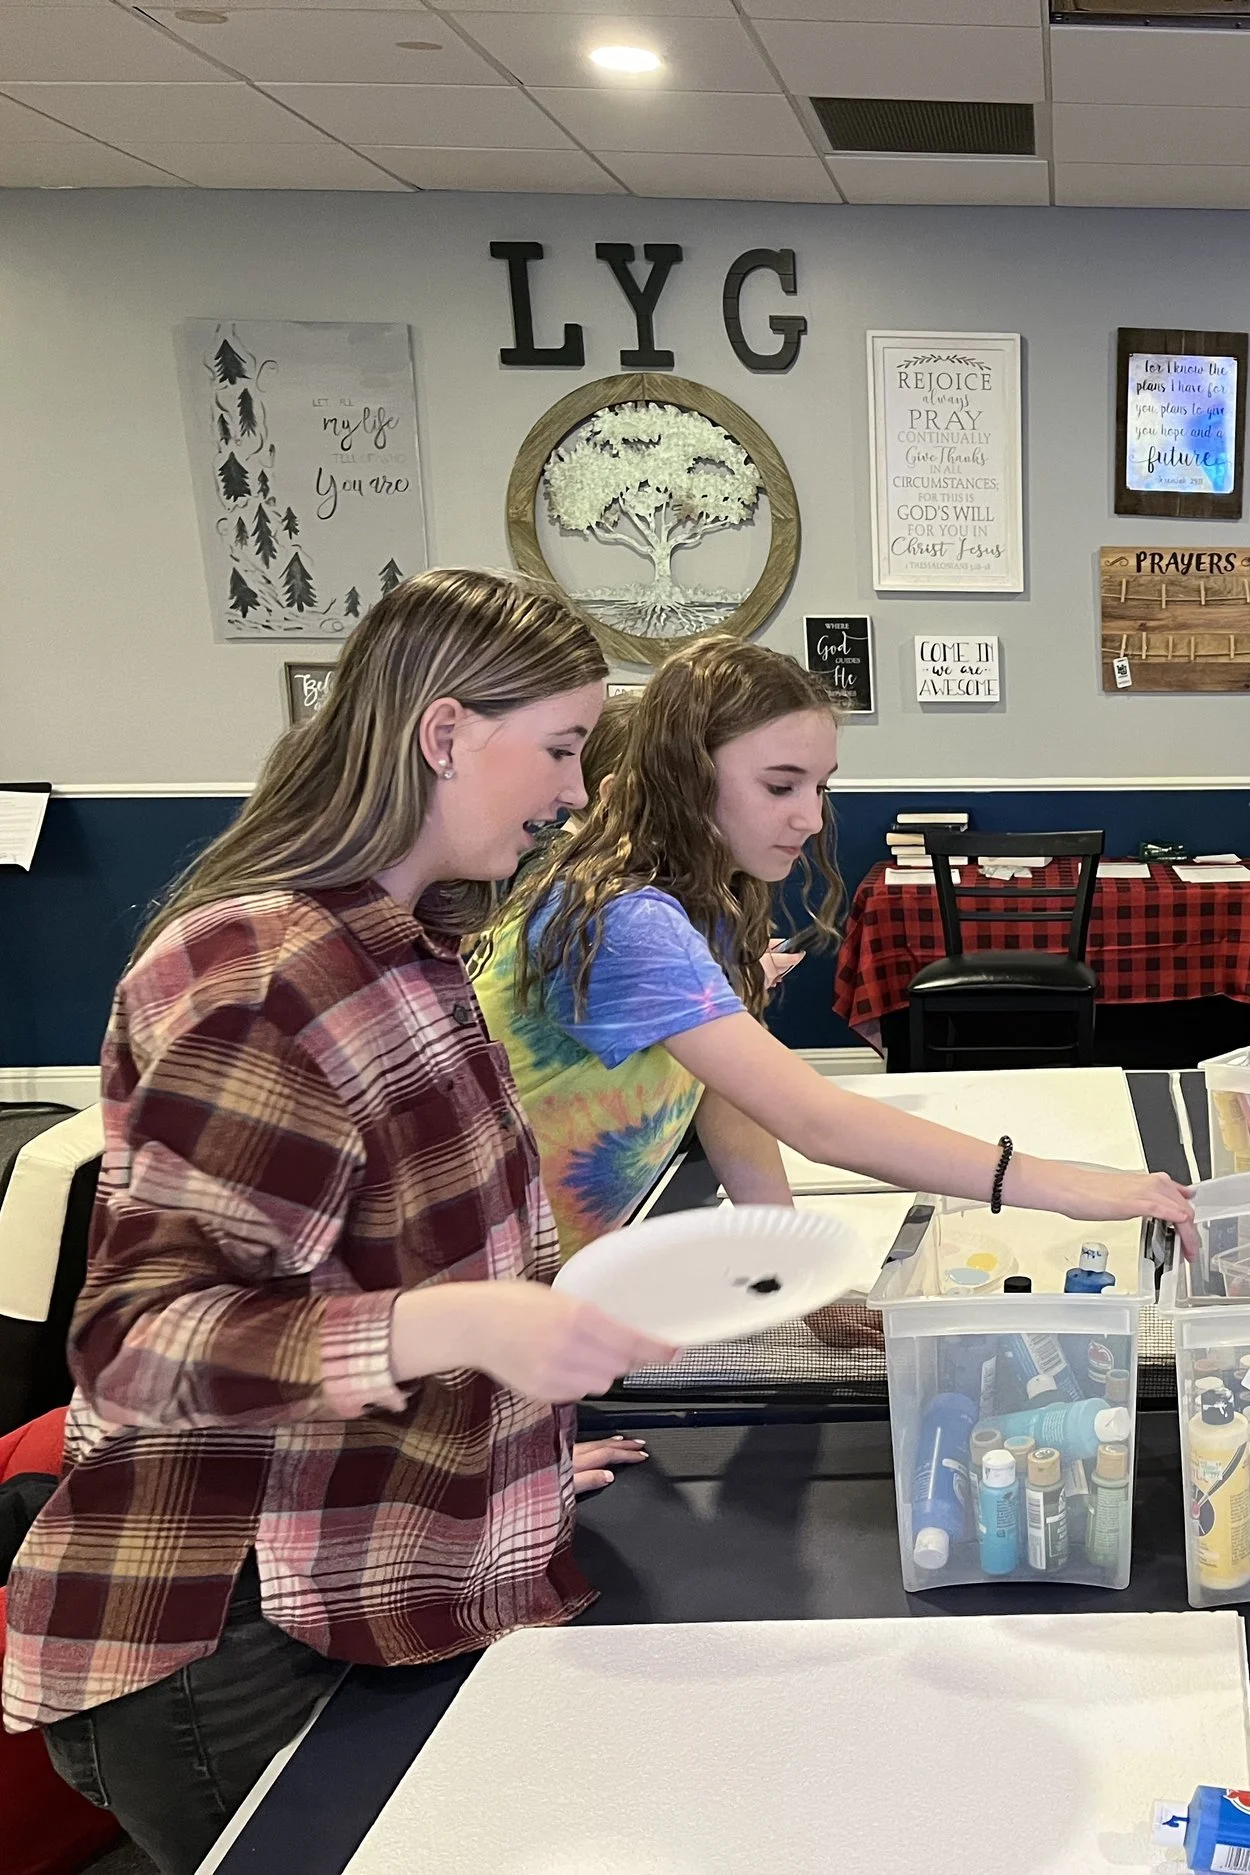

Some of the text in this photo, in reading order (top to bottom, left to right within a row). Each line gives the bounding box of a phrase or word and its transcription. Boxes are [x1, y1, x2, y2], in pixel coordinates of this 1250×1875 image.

[1173, 361, 1205, 375] know
[1209, 363, 1228, 376] the
[898, 371, 992, 392] REJOICE
[1136, 379, 1166, 395] plans
[1178, 380, 1204, 393] have
[1207, 382, 1227, 398] for
[922, 388, 969, 412] always
[908, 409, 984, 431] PRAY
[1161, 402, 1188, 418] plans
[1192, 402, 1204, 415] to
[1206, 406, 1226, 420] give
[323, 406, 400, 452] my life
[897, 431, 991, 445] CONTINUALLY
[1136, 424, 1225, 441] you hope and a
[905, 445, 988, 469] Give Thanks
[1142, 446, 1222, 474] future
[930, 464, 962, 475] IN ALL
[369, 475, 410, 496] are
[892, 476, 999, 491] CIRCUMSTANCES;
[918, 492, 975, 503] FOR THIS IS
[897, 504, 995, 522] GOD'S WILL
[907, 523, 988, 537] FOR YOU IN
[891, 536, 1005, 561] Christ Jesus
[1135, 550, 1237, 575] PRAYERS
[817, 631, 851, 661] God
[920, 641, 994, 662] COME IN
[834, 665, 857, 689] He
[932, 665, 983, 677] we are
[919, 678, 998, 696] AWESOME
